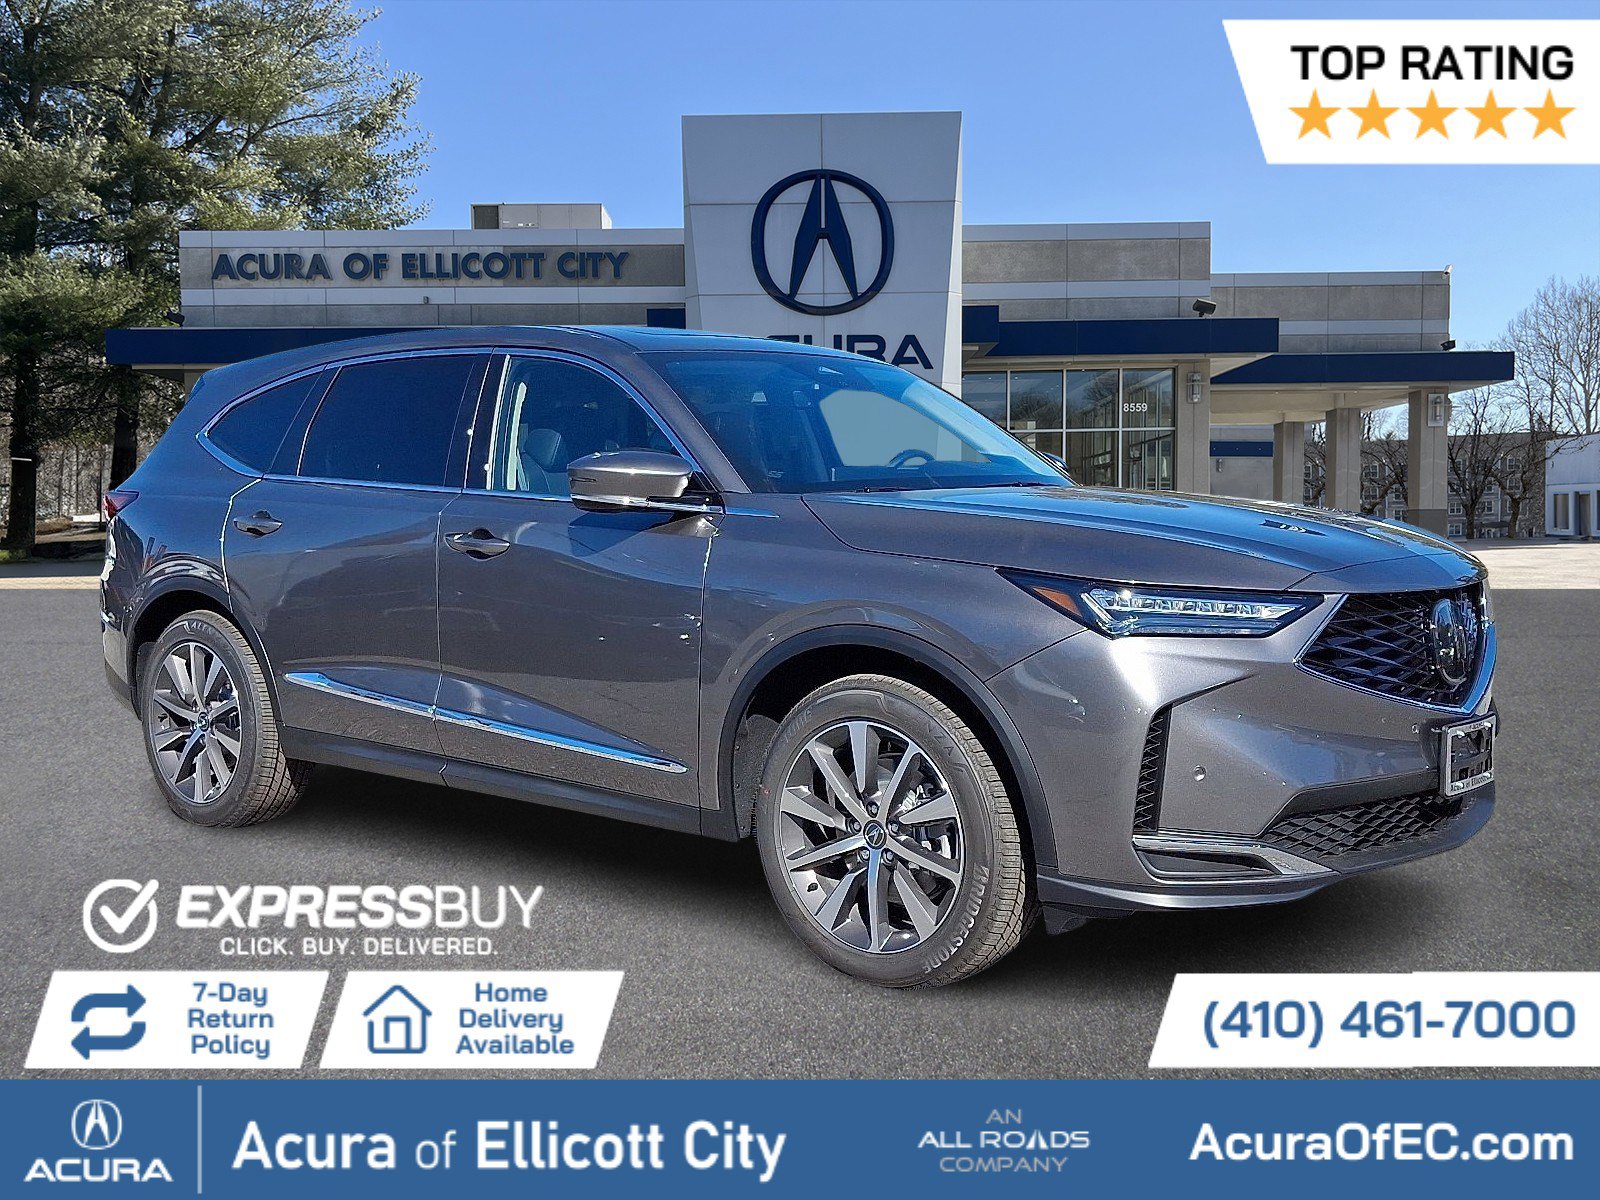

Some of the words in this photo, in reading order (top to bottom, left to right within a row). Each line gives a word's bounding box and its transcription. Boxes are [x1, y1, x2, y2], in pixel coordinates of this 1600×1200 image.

[211, 253, 332, 281] ACURA
[343, 253, 390, 280] OF
[401, 252, 547, 280] ELLICOTT
[556, 252, 630, 280] CITY
[1123, 402, 1148, 413] 8559
